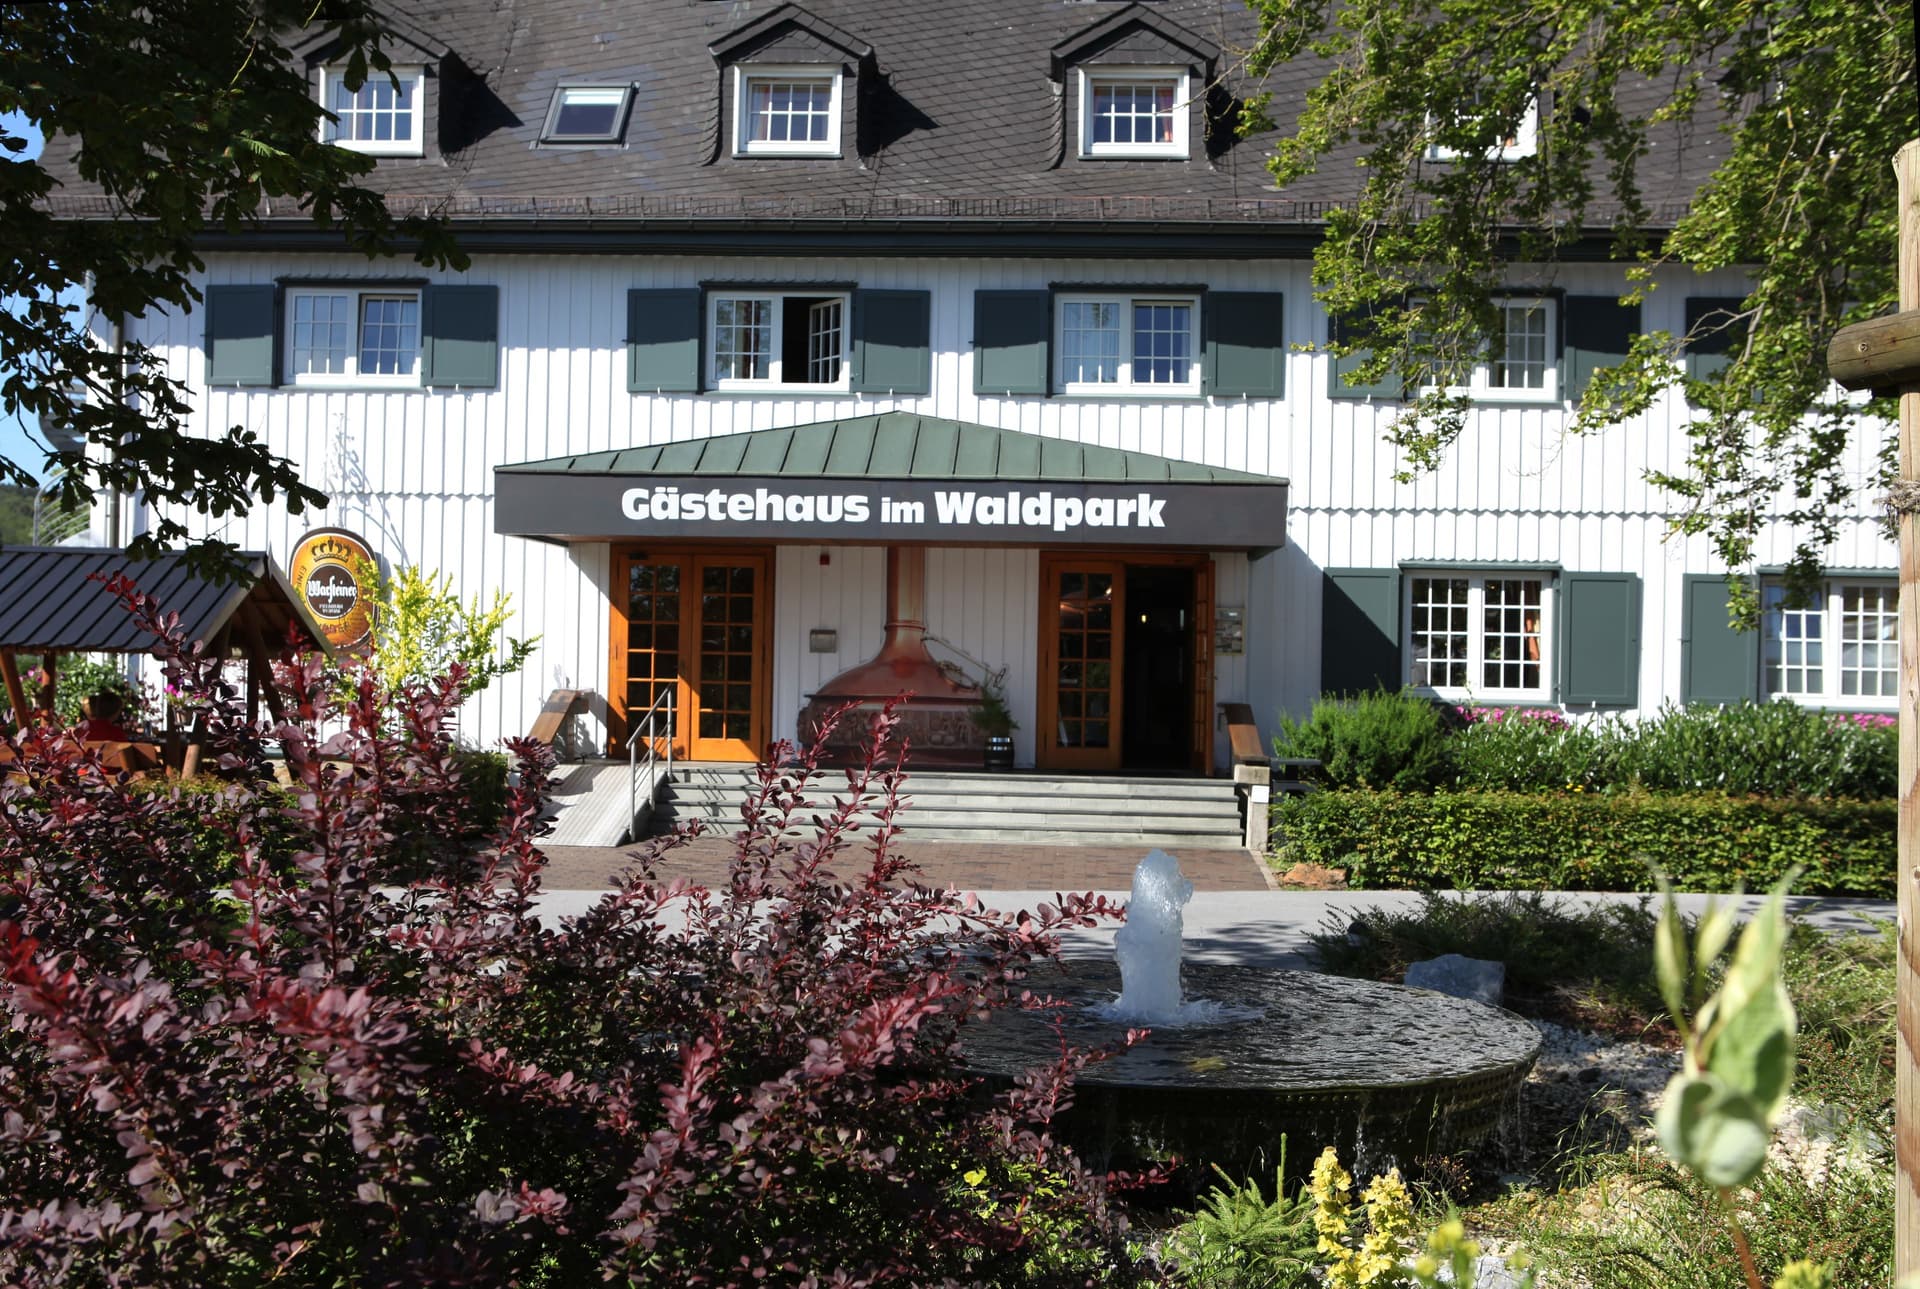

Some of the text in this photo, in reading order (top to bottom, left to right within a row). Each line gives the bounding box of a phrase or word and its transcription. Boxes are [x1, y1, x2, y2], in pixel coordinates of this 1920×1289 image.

[621, 486, 1167, 532] Gästehaus im Waldpark
